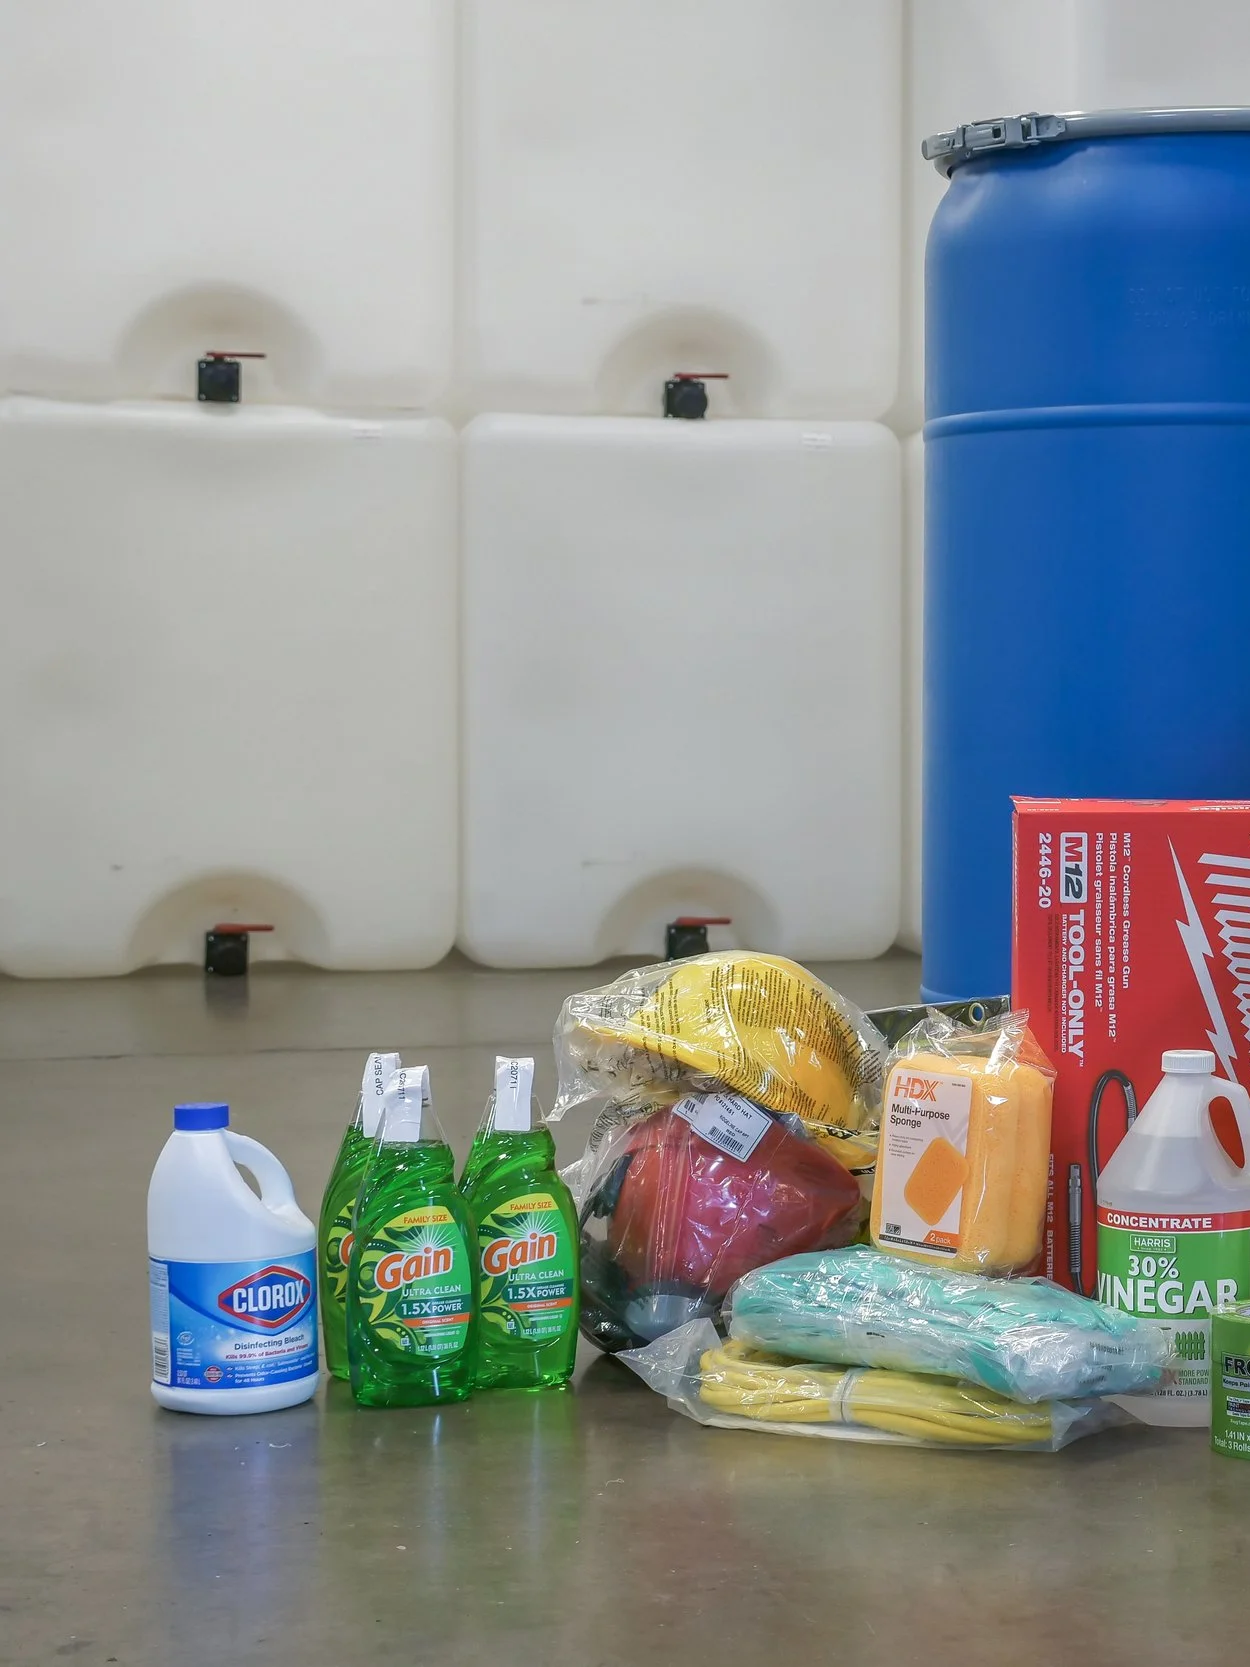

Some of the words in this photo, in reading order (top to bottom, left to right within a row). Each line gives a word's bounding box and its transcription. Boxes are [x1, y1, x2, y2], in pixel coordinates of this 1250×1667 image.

[1095, 833, 1104, 877] Pistolet
[1109, 833, 1118, 872] Pistola
[1038, 832, 1052, 908] 2446-20
[1064, 836, 1083, 900] M12
[1122, 865, 1131, 917] Cordless
[1093, 880, 1103, 936] graisseur
[1109, 876, 1117, 944] inalámbrica
[1122, 920, 1131, 963] Grease
[1107, 946, 1115, 973] para
[1095, 969, 1103, 980] fil
[1122, 966, 1130, 988] Gun
[1107, 977, 1115, 1010] grasa
[375, 1078, 384, 1096] CAP
[894, 1075, 939, 1102] HDX
[741, 1109, 753, 1120] HAT
[889, 1114, 922, 1129] Sponge
[891, 1103, 950, 1120] Multi-Purpose
[510, 1202, 536, 1211] FAMILY
[538, 1200, 552, 1209] SIZE
[1046, 1201, 1054, 1223] M12
[403, 1214, 430, 1224] FAMILY
[432, 1213, 448, 1222] SIZE
[1107, 1212, 1213, 1229] CONCENTRATE
[935, 1235, 951, 1245] pack
[1134, 1237, 1171, 1247] HARRIS
[481, 1231, 556, 1276] Gain
[1046, 1229, 1054, 1280] BATTERIE
[374, 1246, 453, 1292] Gain
[508, 1273, 538, 1282] ULTRA
[539, 1271, 565, 1280] CLEAN
[1128, 1254, 1180, 1279] 30%
[232, 1279, 305, 1313] CLOROX
[402, 1286, 432, 1297] ULTRA
[435, 1284, 462, 1294] CLEAN
[507, 1286, 537, 1299] 1.5X
[537, 1287, 565, 1297] POWER
[1098, 1270, 1239, 1314] VINEGAR
[401, 1301, 432, 1315] 1.5X
[432, 1303, 463, 1313] POWER
[234, 1338, 283, 1351] Disinfecting
[284, 1334, 305, 1345] Bleach
